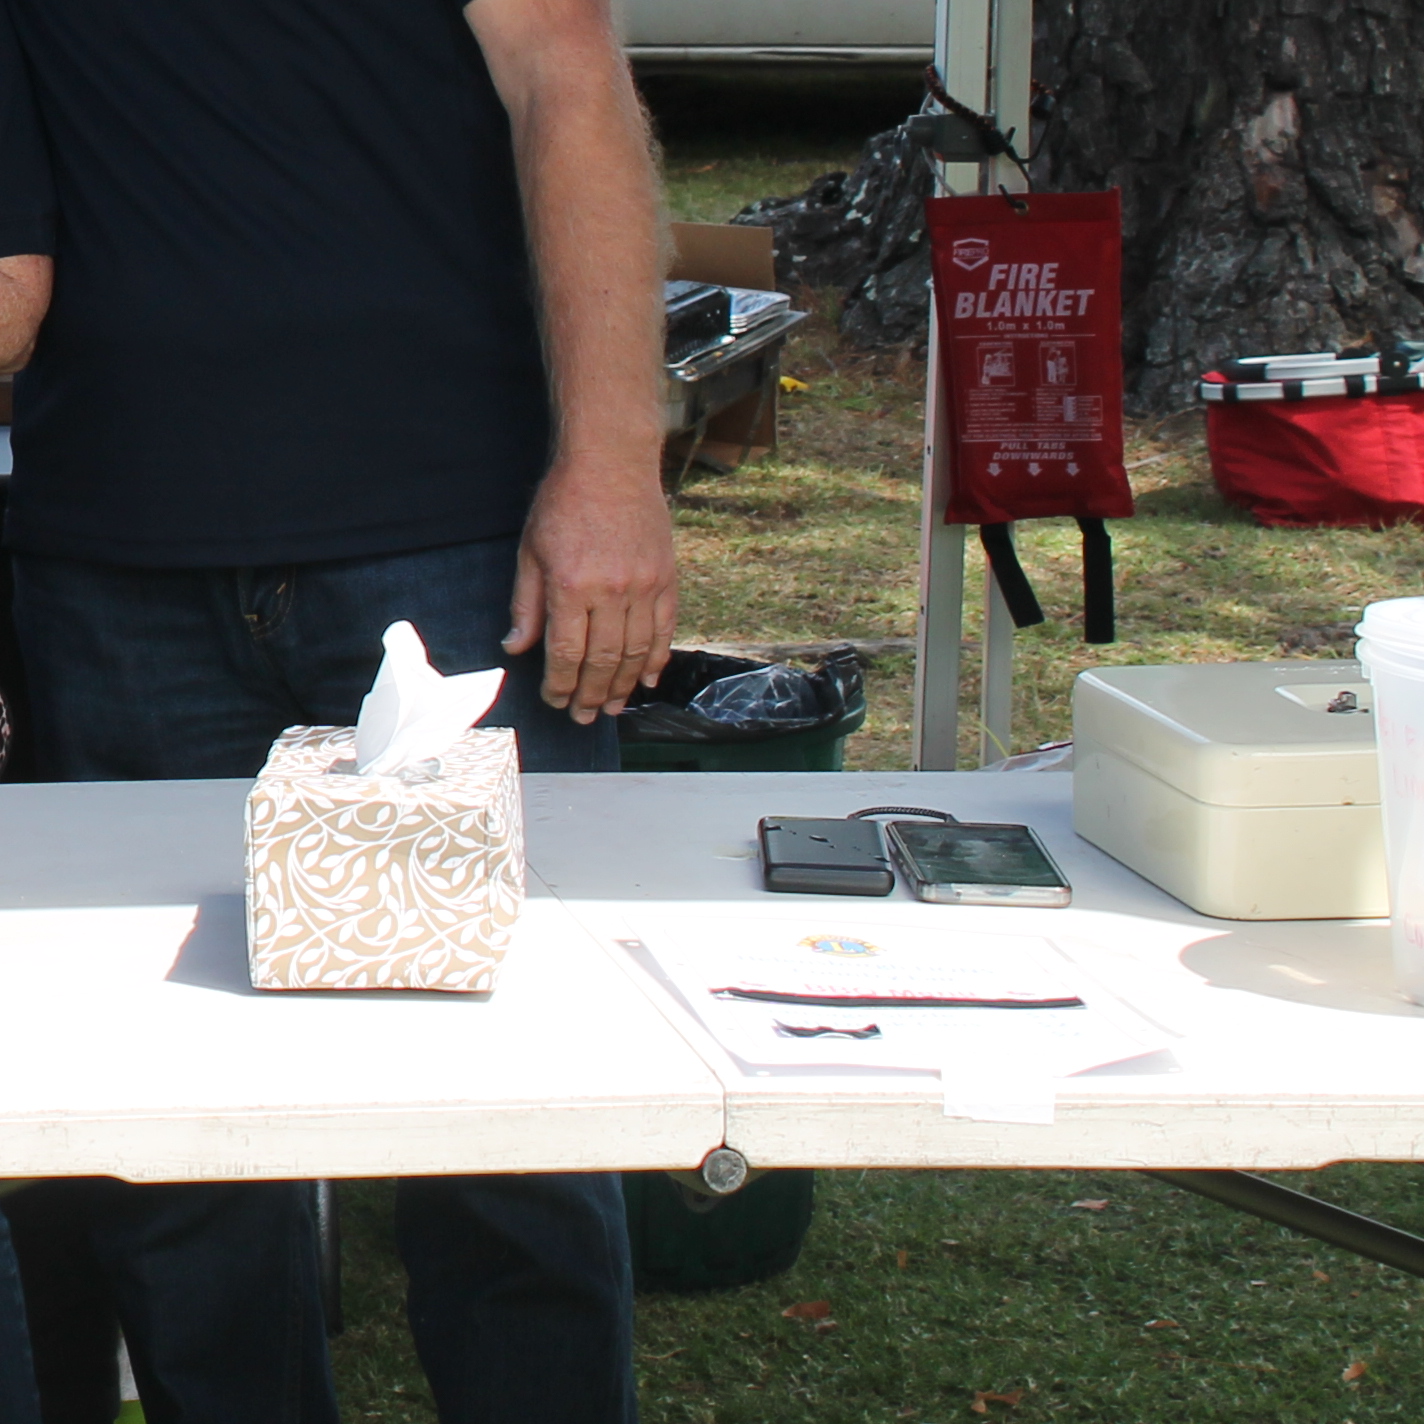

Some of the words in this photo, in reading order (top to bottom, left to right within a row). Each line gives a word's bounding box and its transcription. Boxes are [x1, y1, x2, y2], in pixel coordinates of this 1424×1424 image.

[988, 262, 1059, 290] FIRE
[954, 289, 1095, 319] BLANKET
[987, 321, 1016, 331] 1.0m
[1036, 320, 1065, 330] 1.0m
[1000, 442, 1028, 450] PULL
